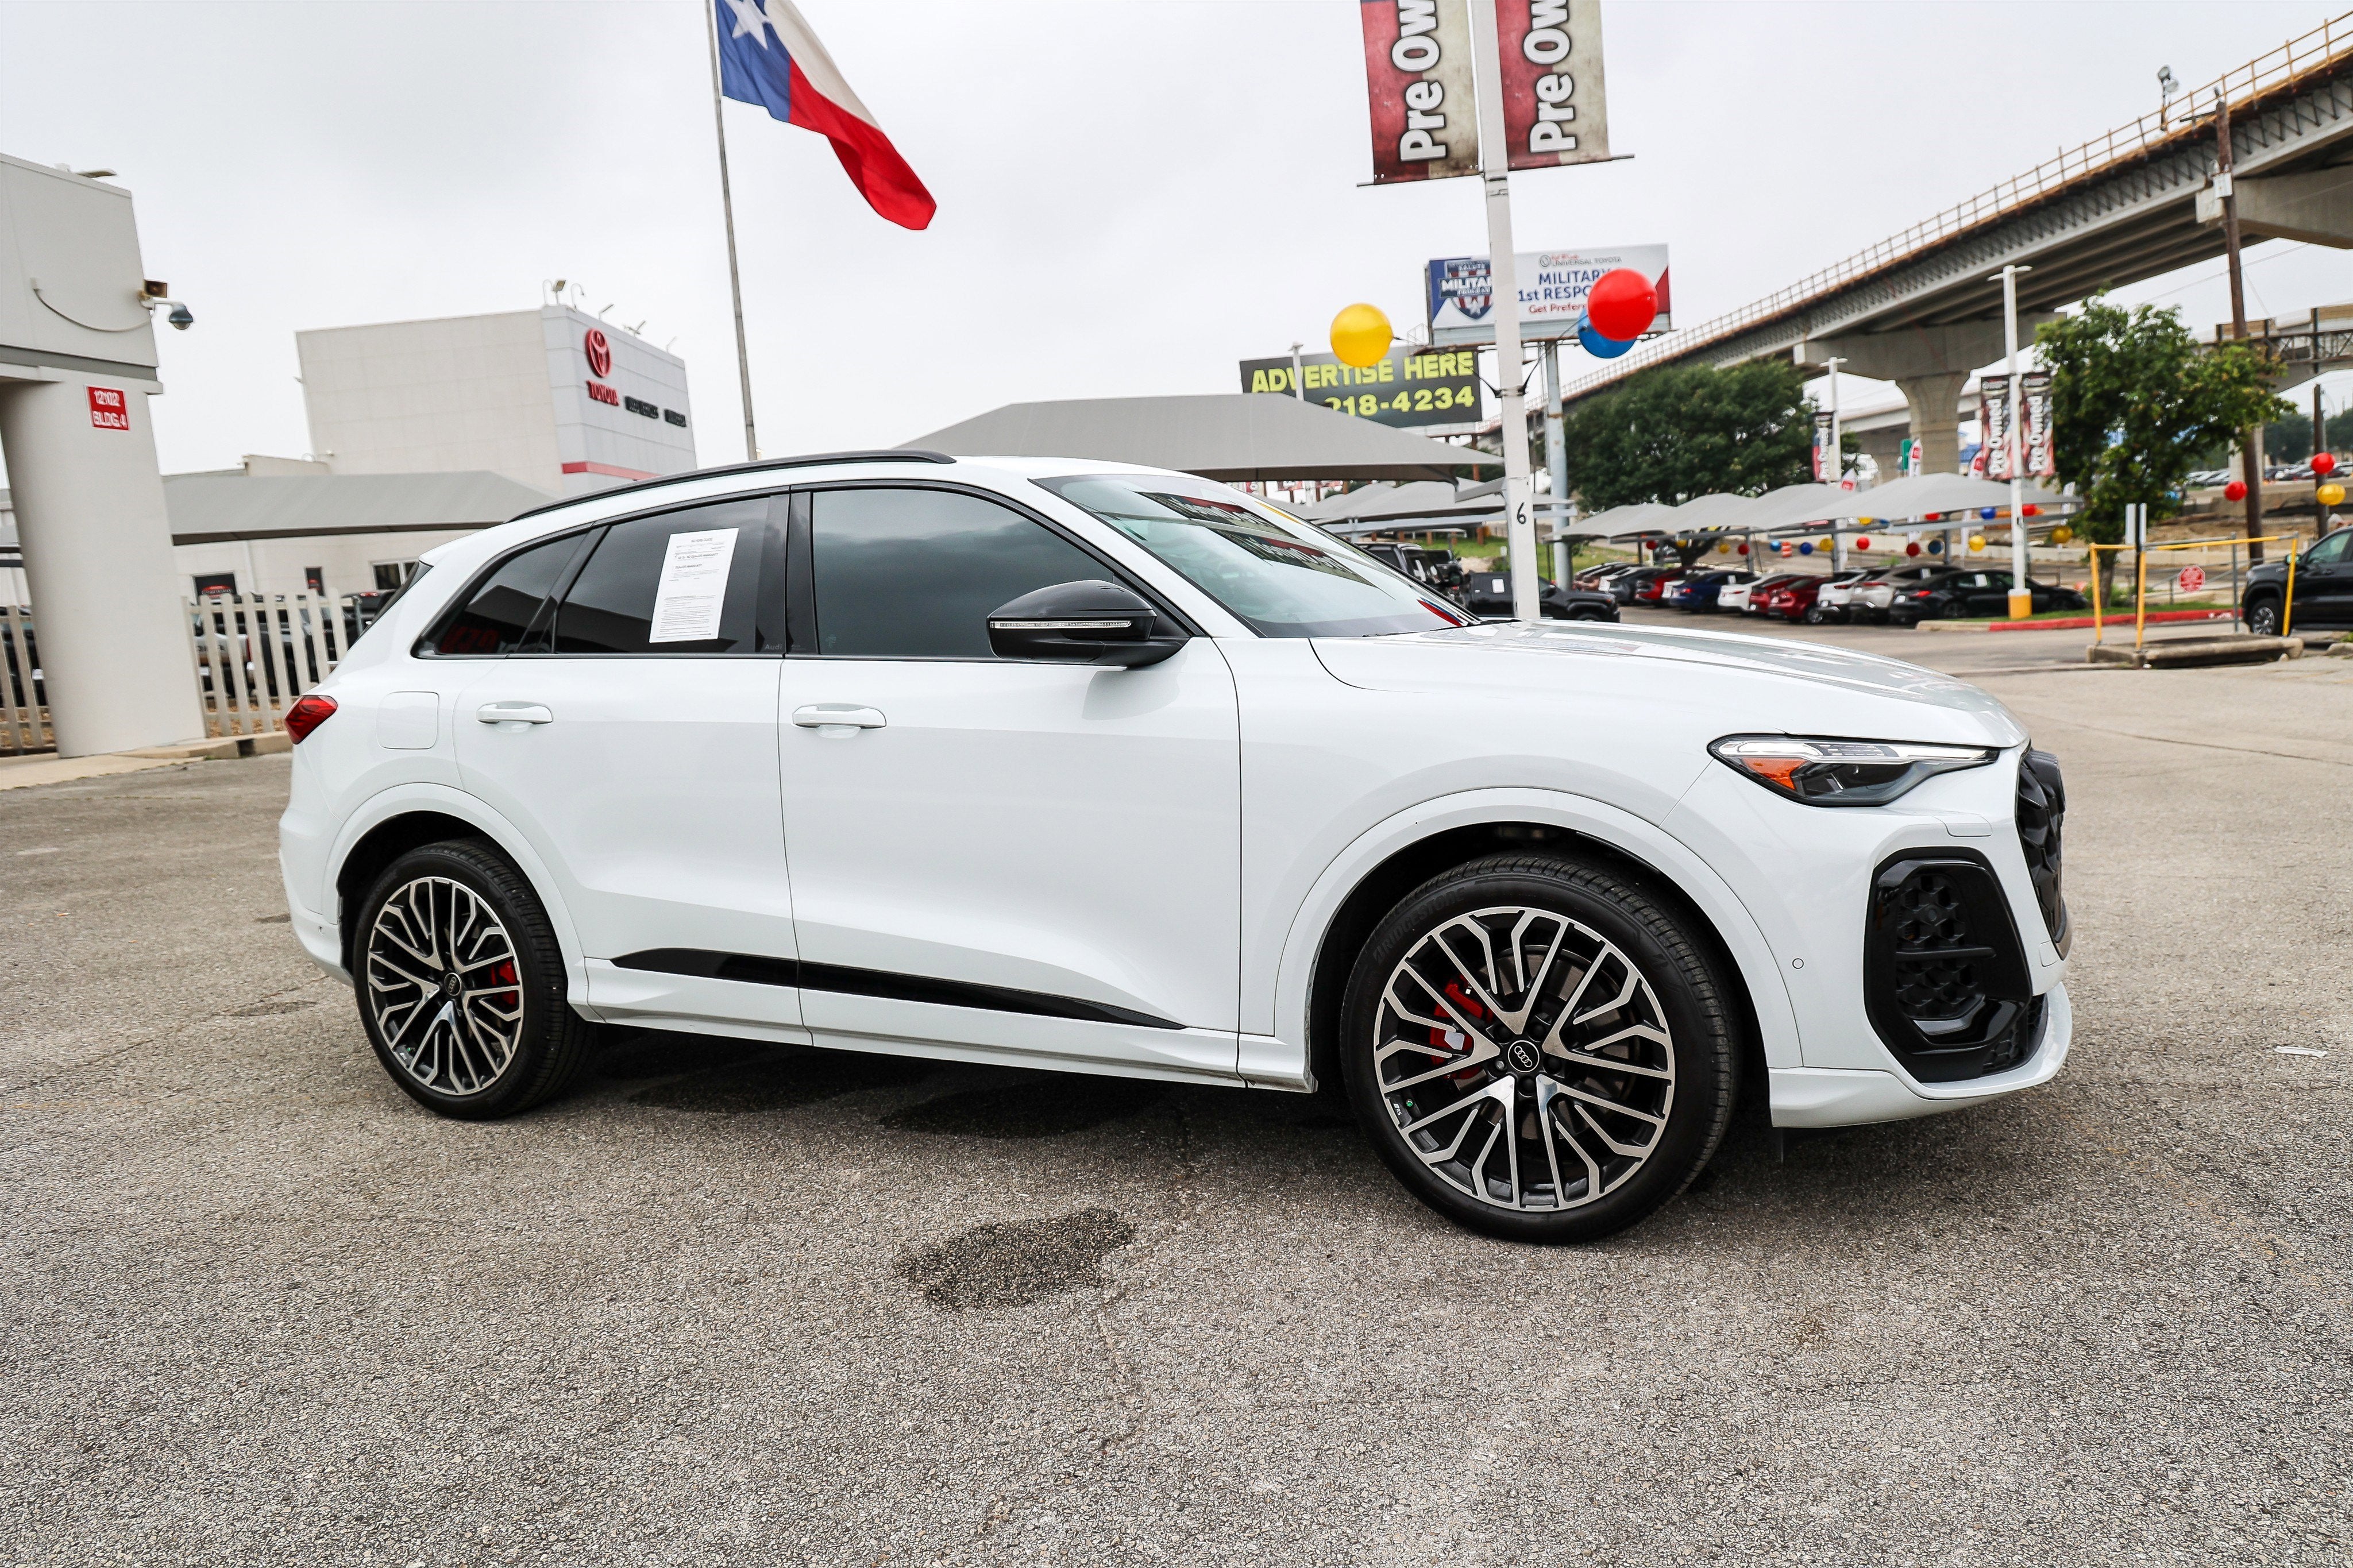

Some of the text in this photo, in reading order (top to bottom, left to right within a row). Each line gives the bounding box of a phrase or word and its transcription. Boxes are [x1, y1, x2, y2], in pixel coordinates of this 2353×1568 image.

[1400, 82, 1446, 161] Pre
[1530, 74, 1576, 153] Pre
[1518, 289, 1539, 301] 1st
[587, 381, 619, 406] TOYOTA
[1252, 352, 1474, 393] ADVERTISE HERE
[1986, 399, 2003, 449] Owned
[2027, 396, 2043, 446] Owned
[1517, 501, 1526, 524] 6
